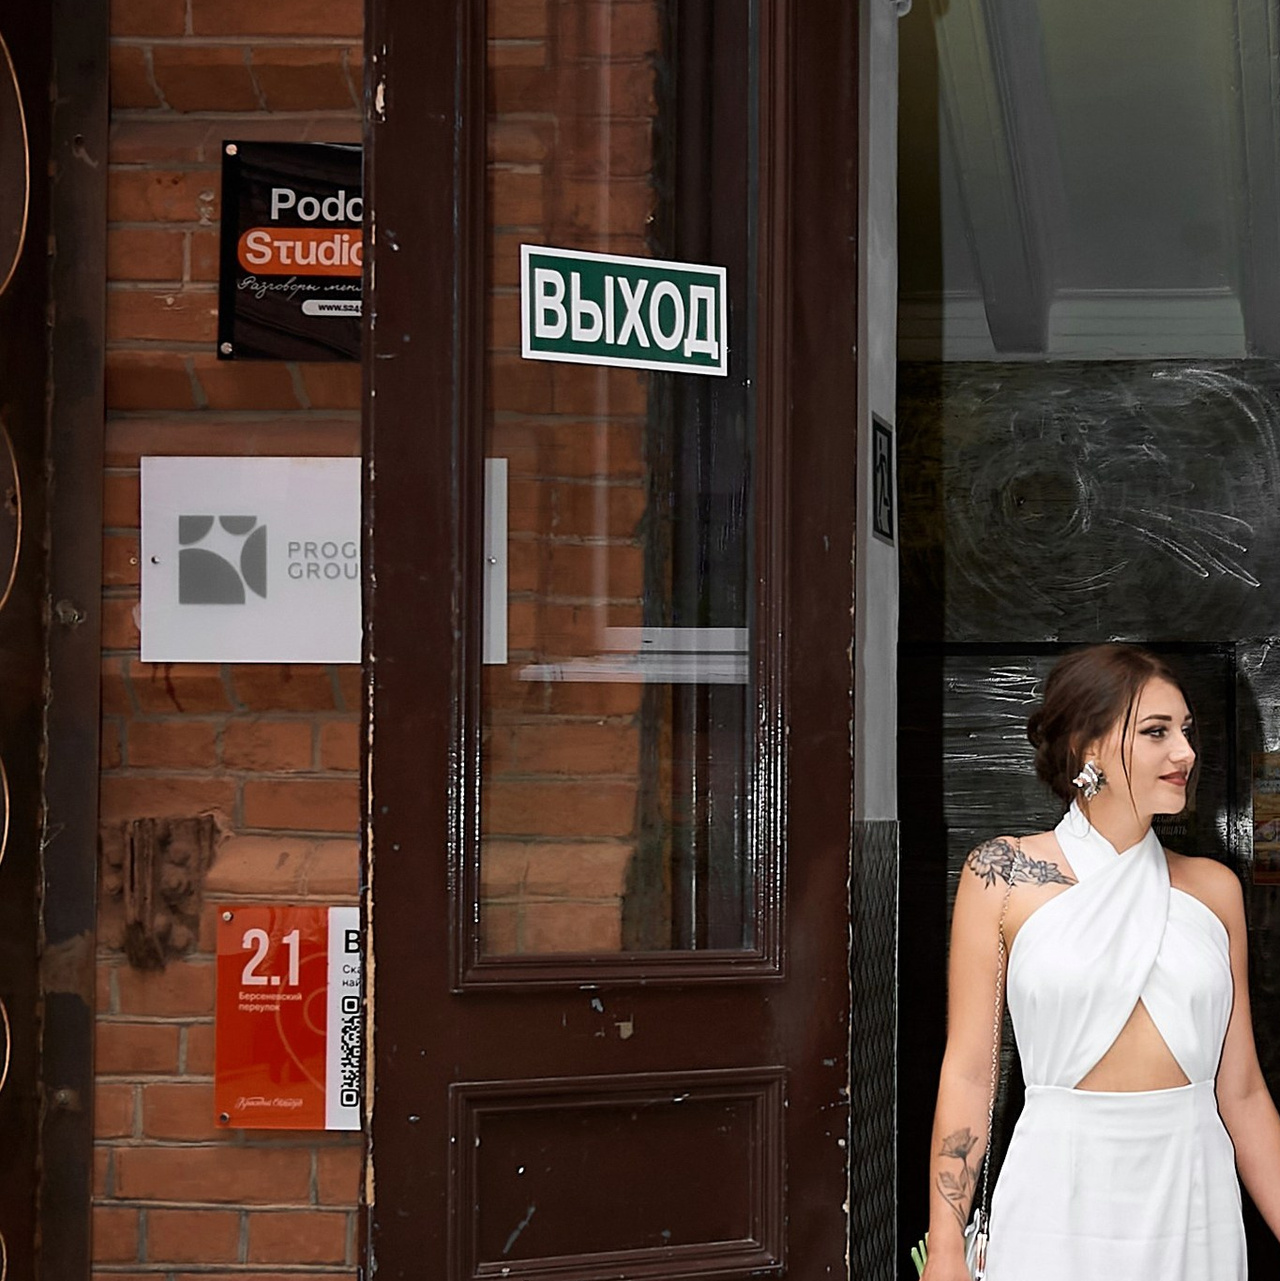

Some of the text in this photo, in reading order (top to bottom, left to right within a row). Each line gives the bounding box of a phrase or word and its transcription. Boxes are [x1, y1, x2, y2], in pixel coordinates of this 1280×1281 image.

[534, 267, 719, 360] ВЫХОД
[288, 541, 357, 559] PROG
[288, 562, 359, 580] GROU
[241, 928, 300, 987] 2.1
